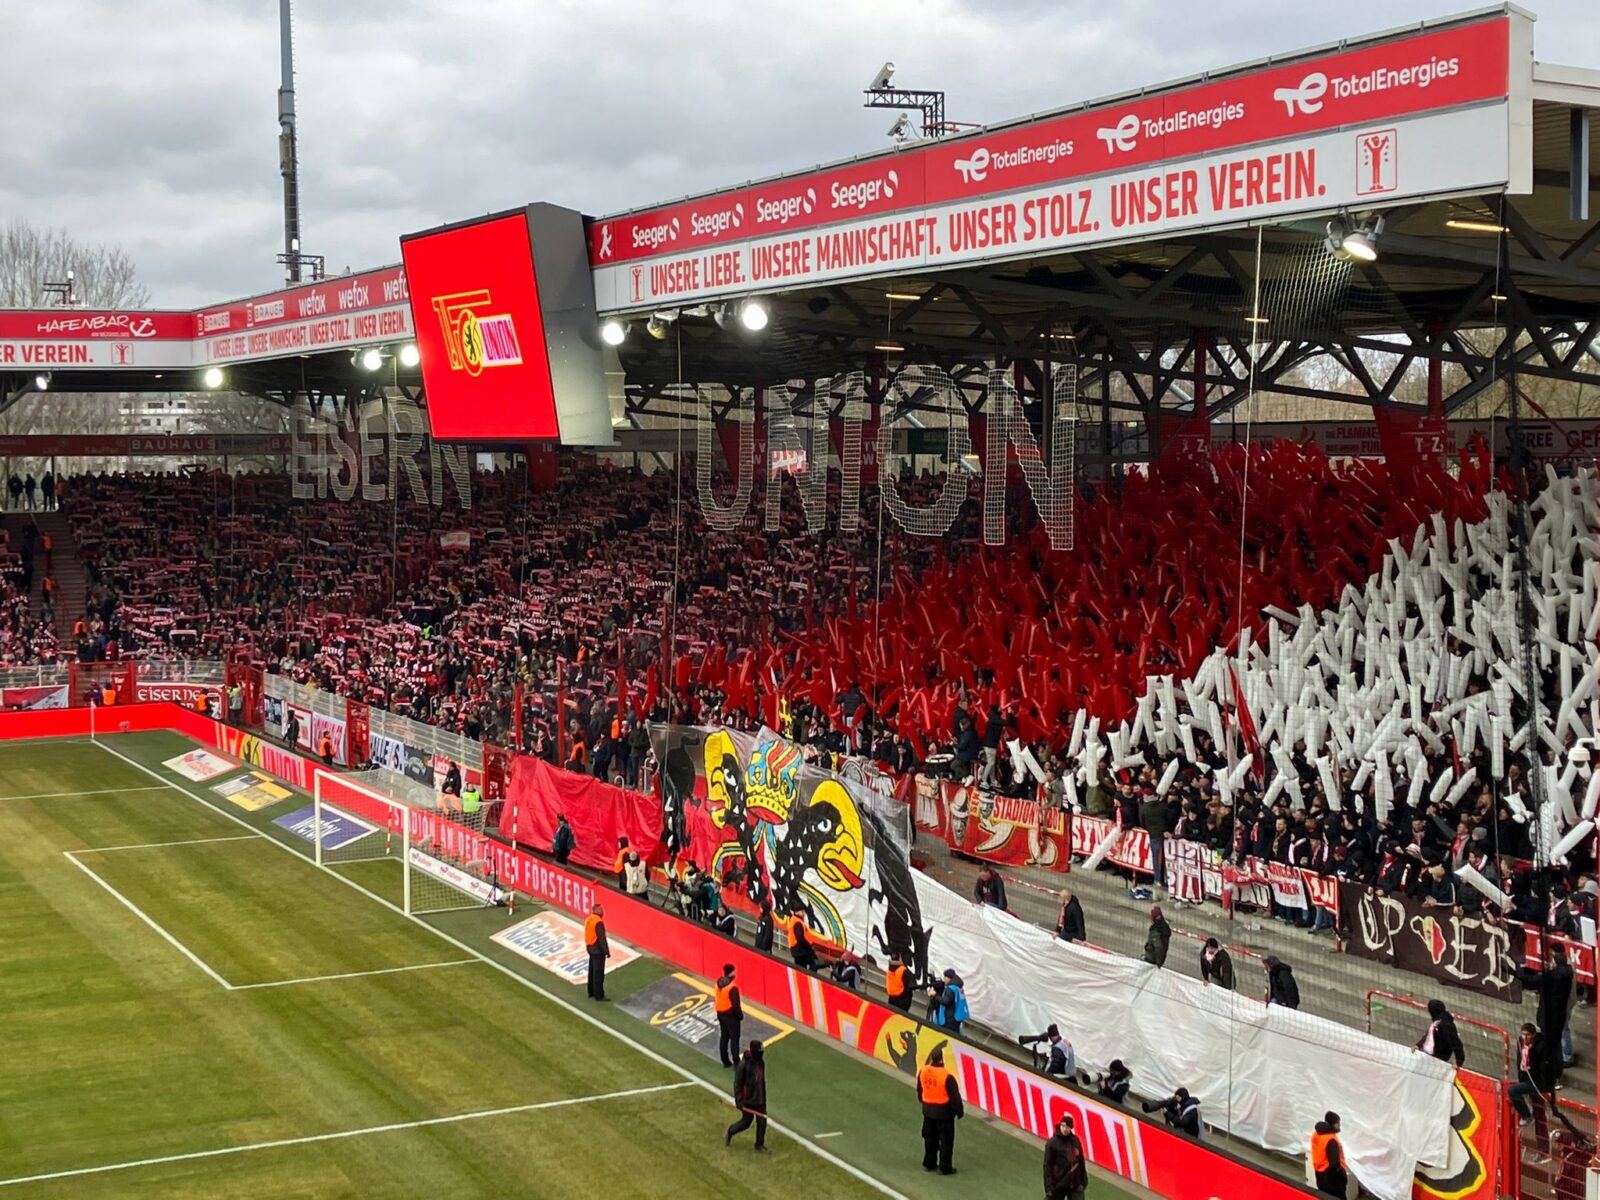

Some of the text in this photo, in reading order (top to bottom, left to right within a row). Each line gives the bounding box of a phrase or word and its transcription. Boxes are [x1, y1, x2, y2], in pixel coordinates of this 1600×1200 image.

[1331, 55, 1460, 98] TotalEnergies
[1142, 100, 1246, 139] TotalEnergies
[992, 138, 1075, 172] TotalEnergies
[831, 179, 882, 210] Seeger
[650, 148, 1326, 296] UNSERE LIEBE. UNSERE MANNSCHAFT. UNSER STOLZ. UNSER VEREIN.
[756, 196, 802, 224] Seeger
[632, 225, 670, 248] Seeger
[691, 212, 732, 238] Seeger
[298, 289, 326, 317] wefox
[338, 280, 369, 309] wefox
[37, 315, 129, 333] HAFENBAR
[21, 345, 94, 363] VEREIN.
[480, 320, 519, 360] UNION
[131, 438, 216, 451] BAUHAUS
[697, 364, 1077, 551] UNION
